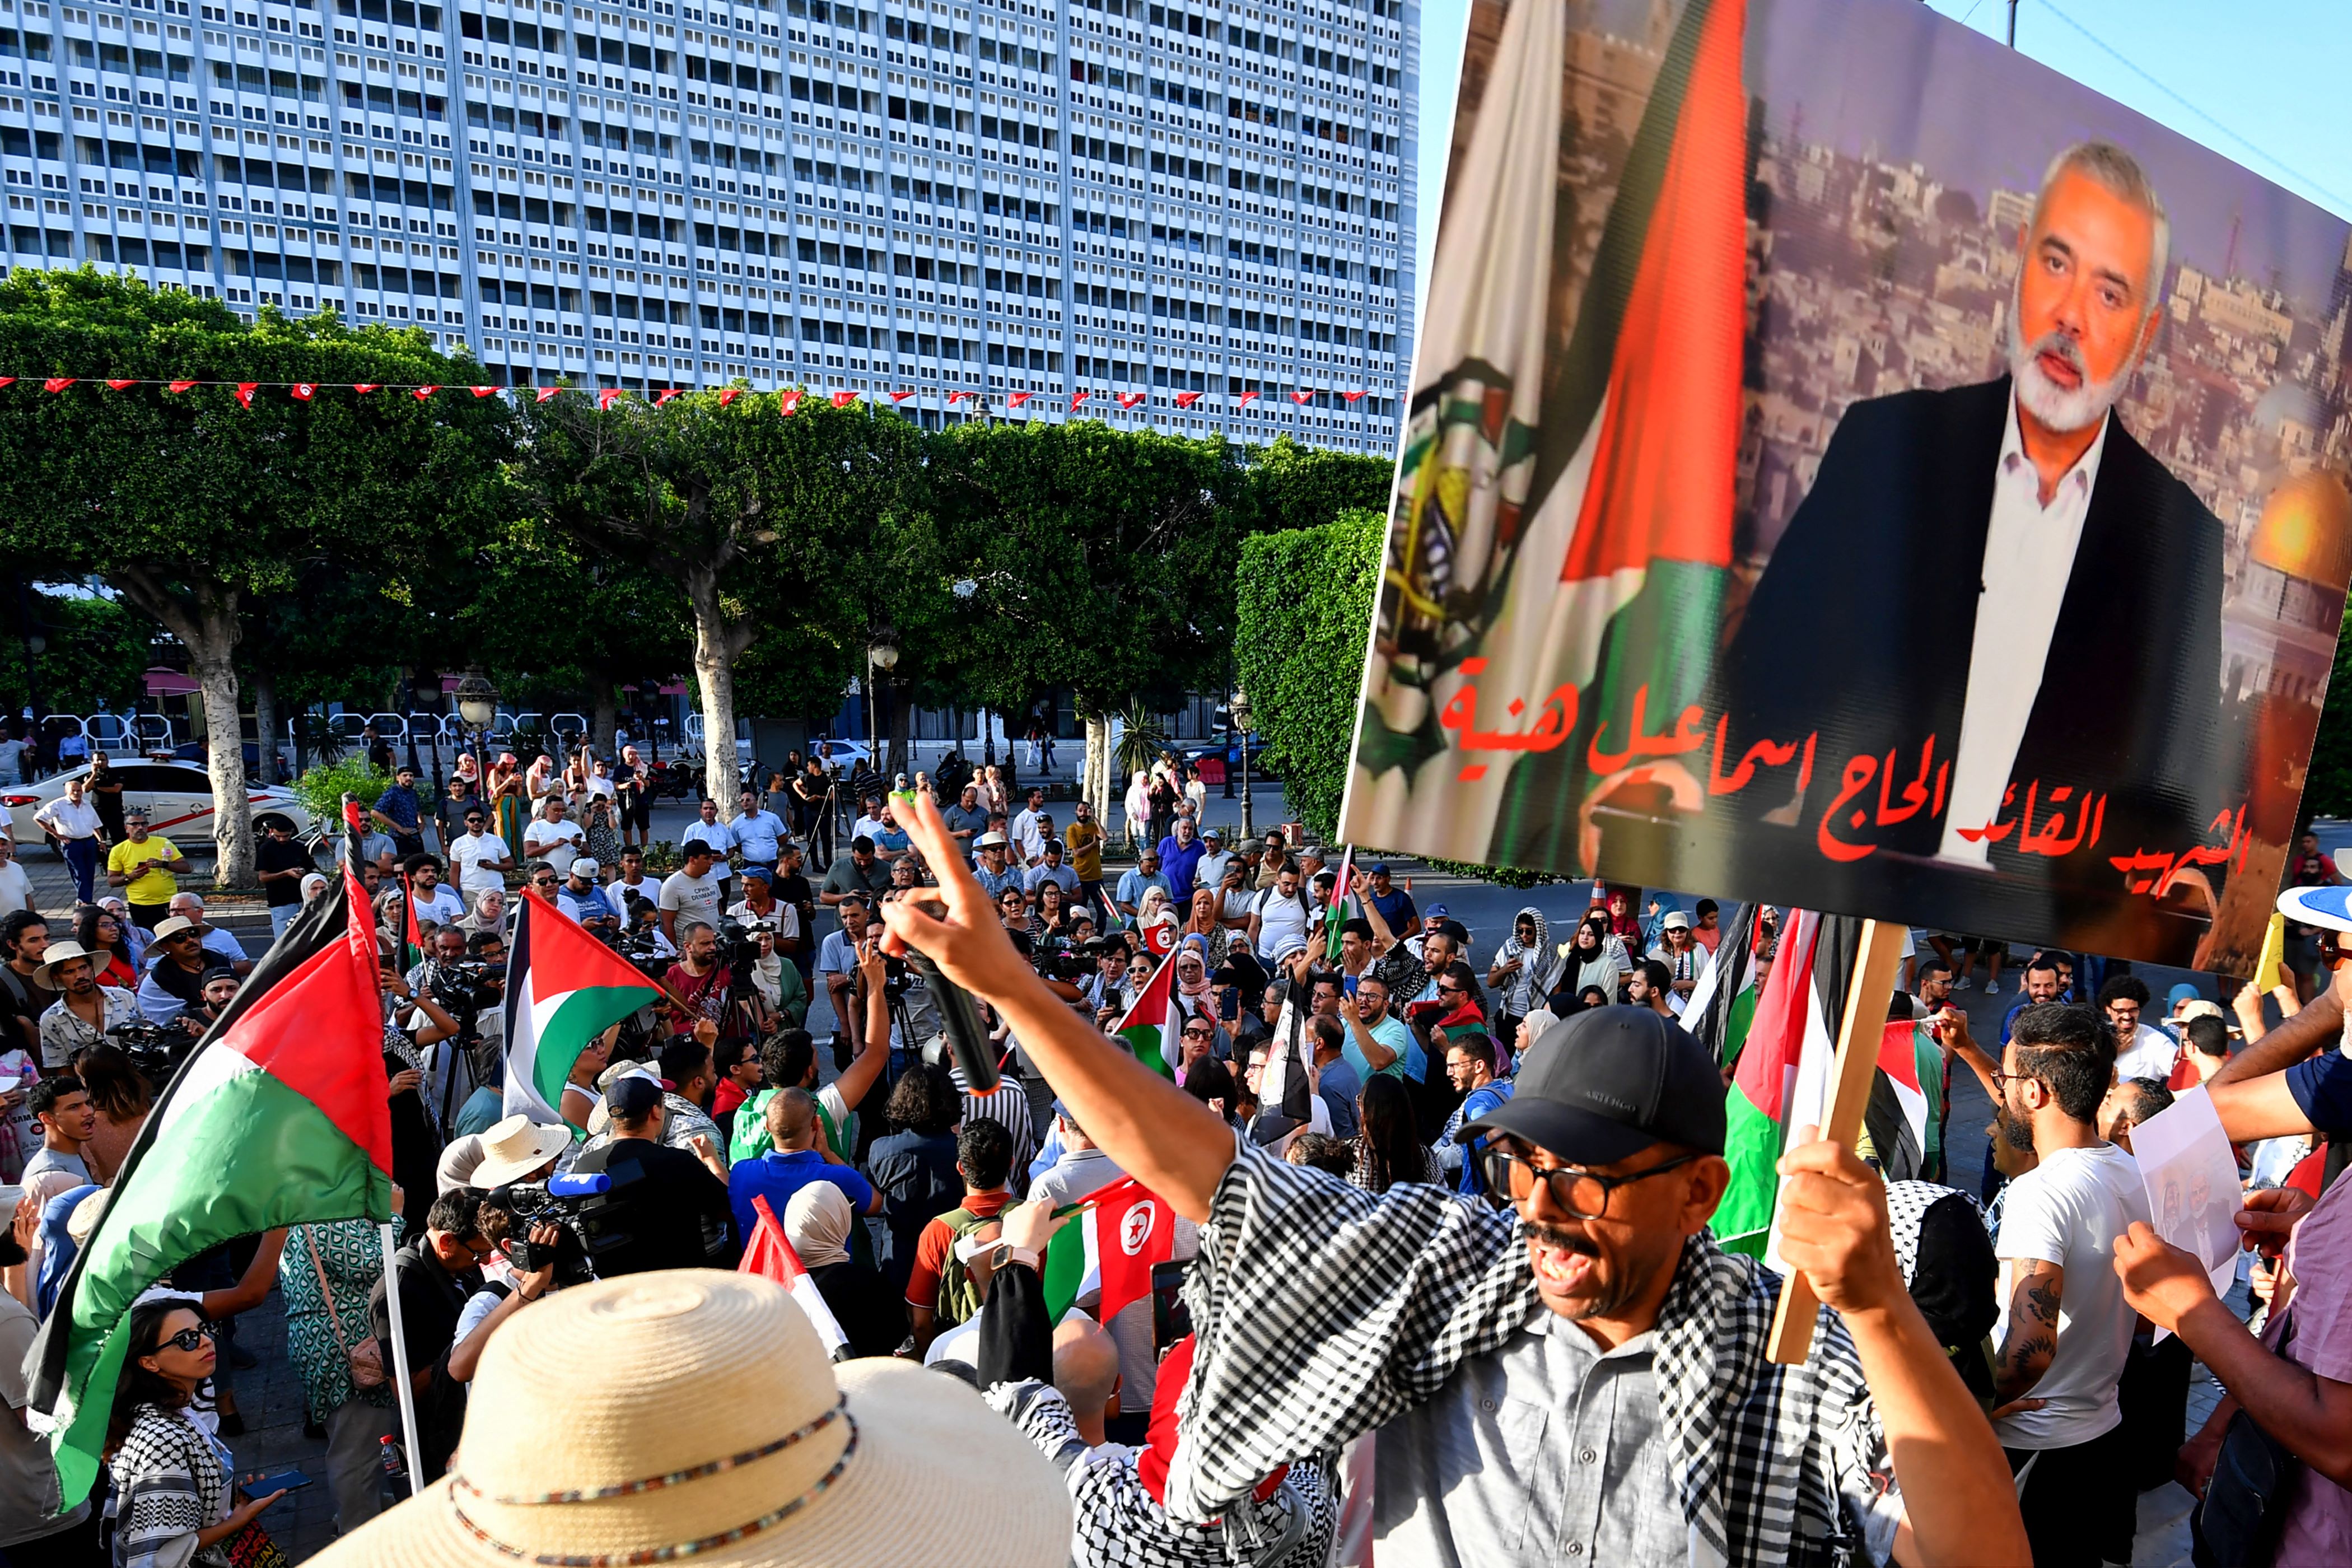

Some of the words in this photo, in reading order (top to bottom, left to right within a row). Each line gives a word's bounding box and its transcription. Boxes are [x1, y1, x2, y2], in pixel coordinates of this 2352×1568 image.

[1441, 657, 1579, 782] هنية
[1587, 683, 1817, 795] اسماعيل
[1817, 733, 1949, 861] الحاج
[1956, 779, 2107, 856] القائد
[2110, 804, 2252, 900] الشهيد
